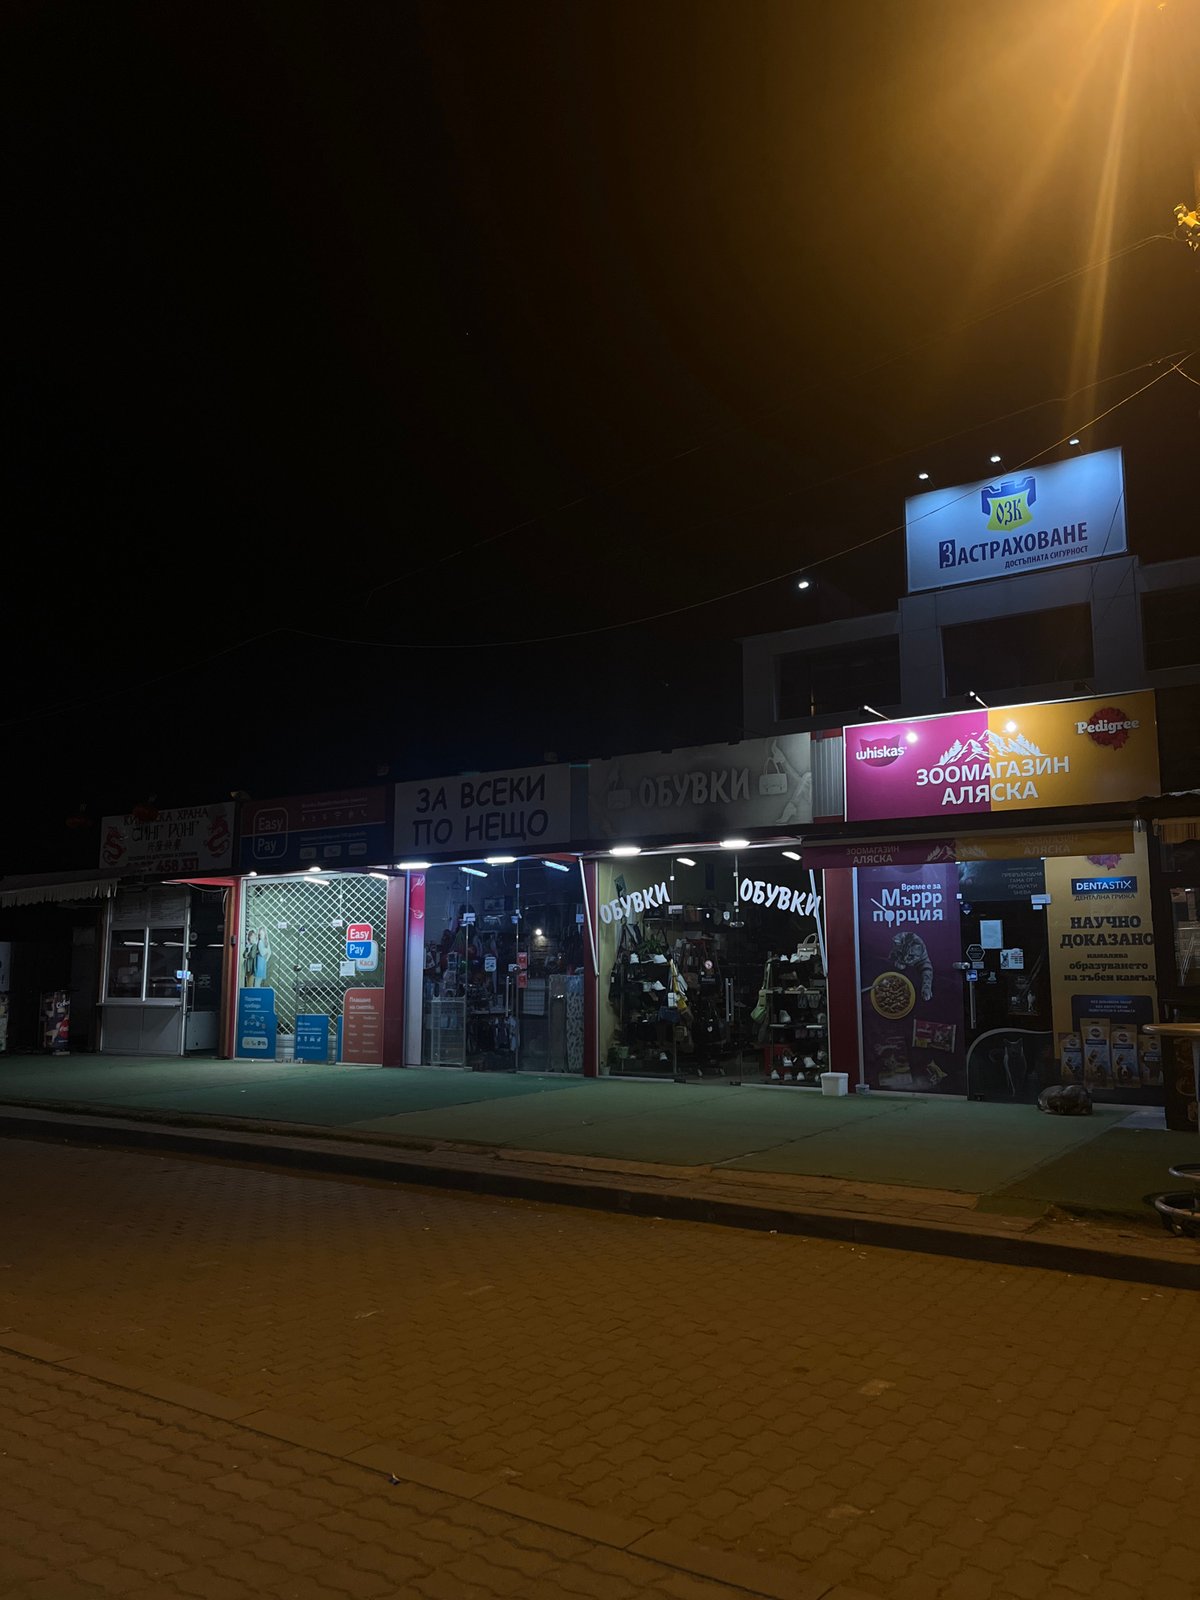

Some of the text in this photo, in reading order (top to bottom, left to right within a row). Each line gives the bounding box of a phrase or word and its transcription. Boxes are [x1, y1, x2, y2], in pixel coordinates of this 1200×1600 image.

[996, 499, 1022, 525] ОЗК
[939, 522, 1088, 568] ЗАСТРАХОВАНЕ
[1004, 545, 1089, 569] ДОСТЪПНАТА СИГУРНОСТ
[1074, 719, 1140, 734] Pedigree
[855, 746, 905, 761] whiskas
[916, 755, 1070, 786] ЗООМАГАЗИН
[415, 773, 546, 814] ЗА ВСЕКИ
[639, 768, 751, 808] ОБУВКИ
[941, 781, 1039, 805] АЛЯСКА
[177, 807, 209, 821] ХРАНА
[258, 816, 283, 832] Easy
[412, 809, 549, 847] ПО НЕЩО
[257, 838, 277, 853] Pay
[846, 845, 900, 856] ЗООМАГАЗИН
[1023, 844, 1070, 855] АЛЯСКА
[853, 854, 893, 865] АЛЯСКА
[901, 883, 926, 892] Време
[1076, 880, 1132, 891] DENTASTIX
[600, 881, 671, 925] ОБУВКИ
[739, 877, 822, 919] ОБУВКИ
[873, 909, 943, 926] порция
[1070, 915, 1142, 929] НАУЧНО
[350, 928, 370, 940] Easy
[1060, 933, 1155, 949] ДОКАЗАНО
[350, 943, 365, 956] Pay
[1069, 961, 1148, 972] образуването
[1064, 974, 1077, 982] на
[1080, 972, 1114, 982] зъбен
